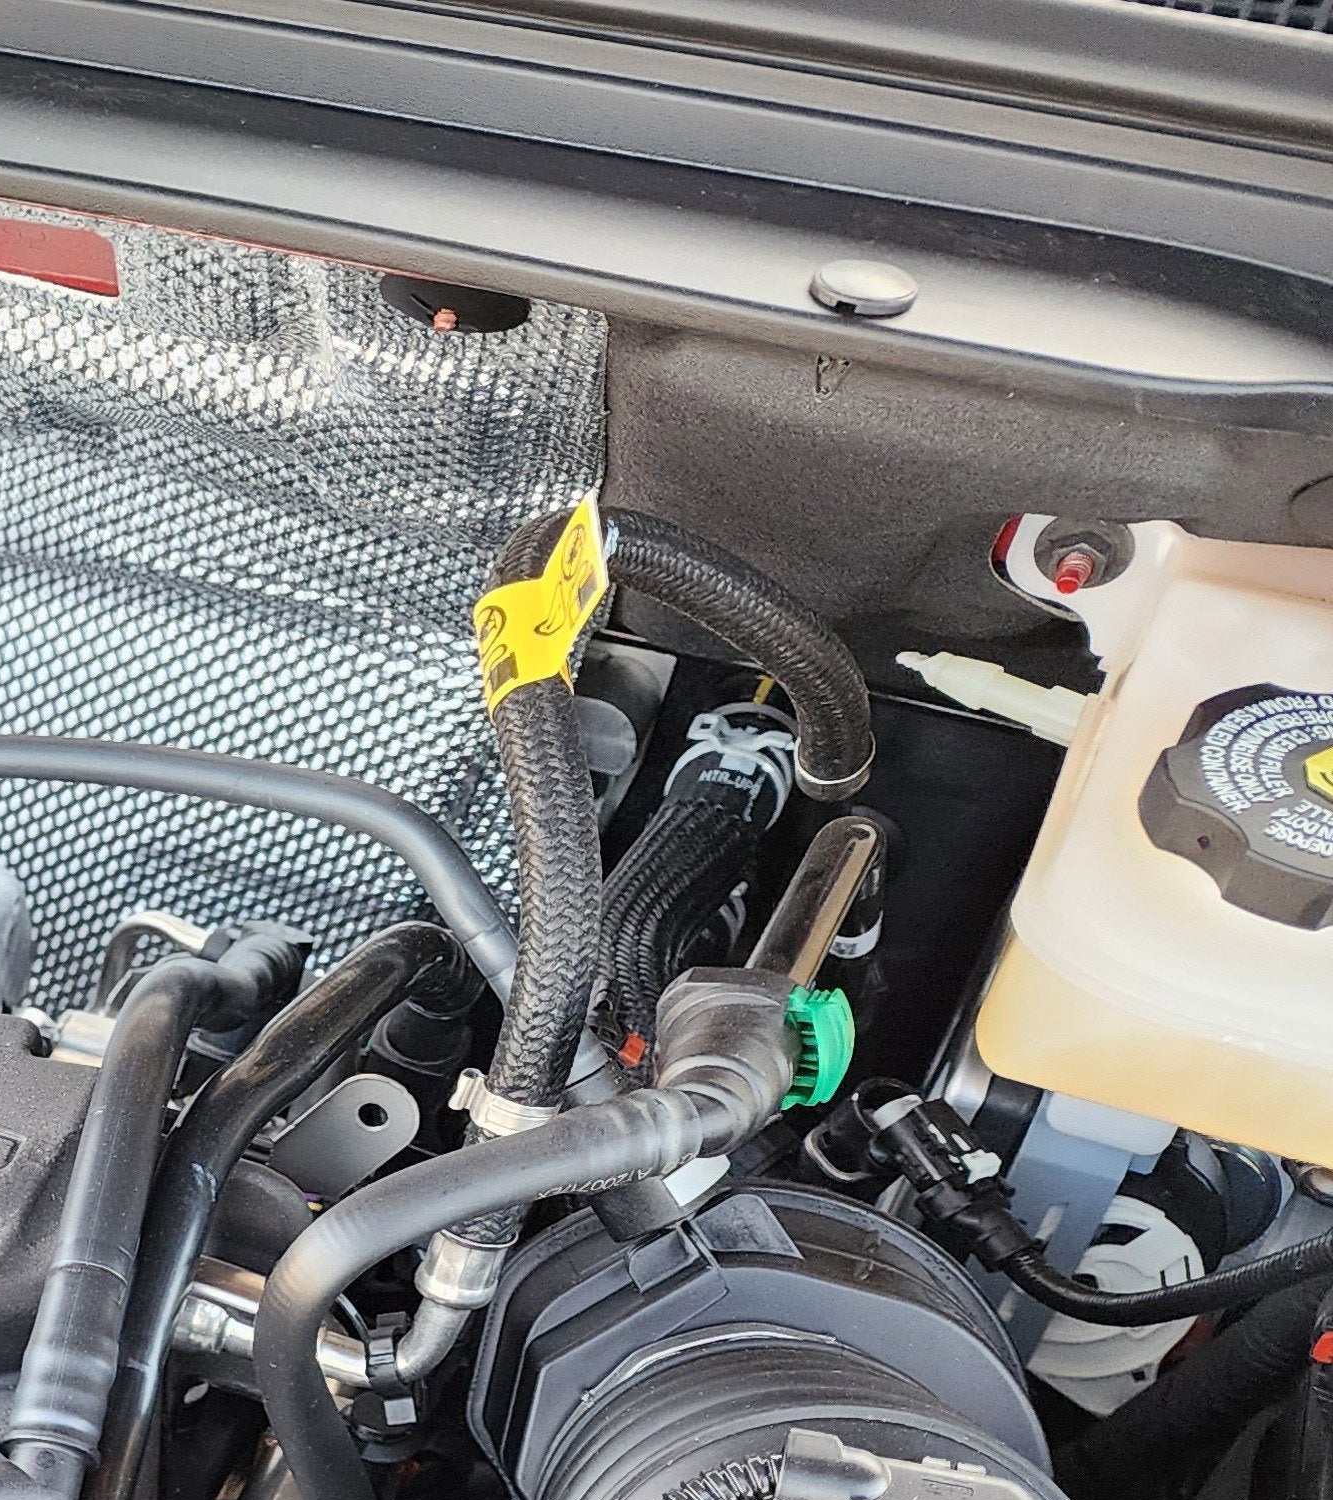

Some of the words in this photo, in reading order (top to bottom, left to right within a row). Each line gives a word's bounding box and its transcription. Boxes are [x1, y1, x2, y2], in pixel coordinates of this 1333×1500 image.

[1244, 703, 1266, 718] A
[1258, 695, 1318, 715] FROM
[1205, 707, 1257, 748] SEALED
[1259, 729, 1312, 761] CLEAN
[1234, 772, 1275, 803] ONLY
[1259, 757, 1295, 799] FILLER
